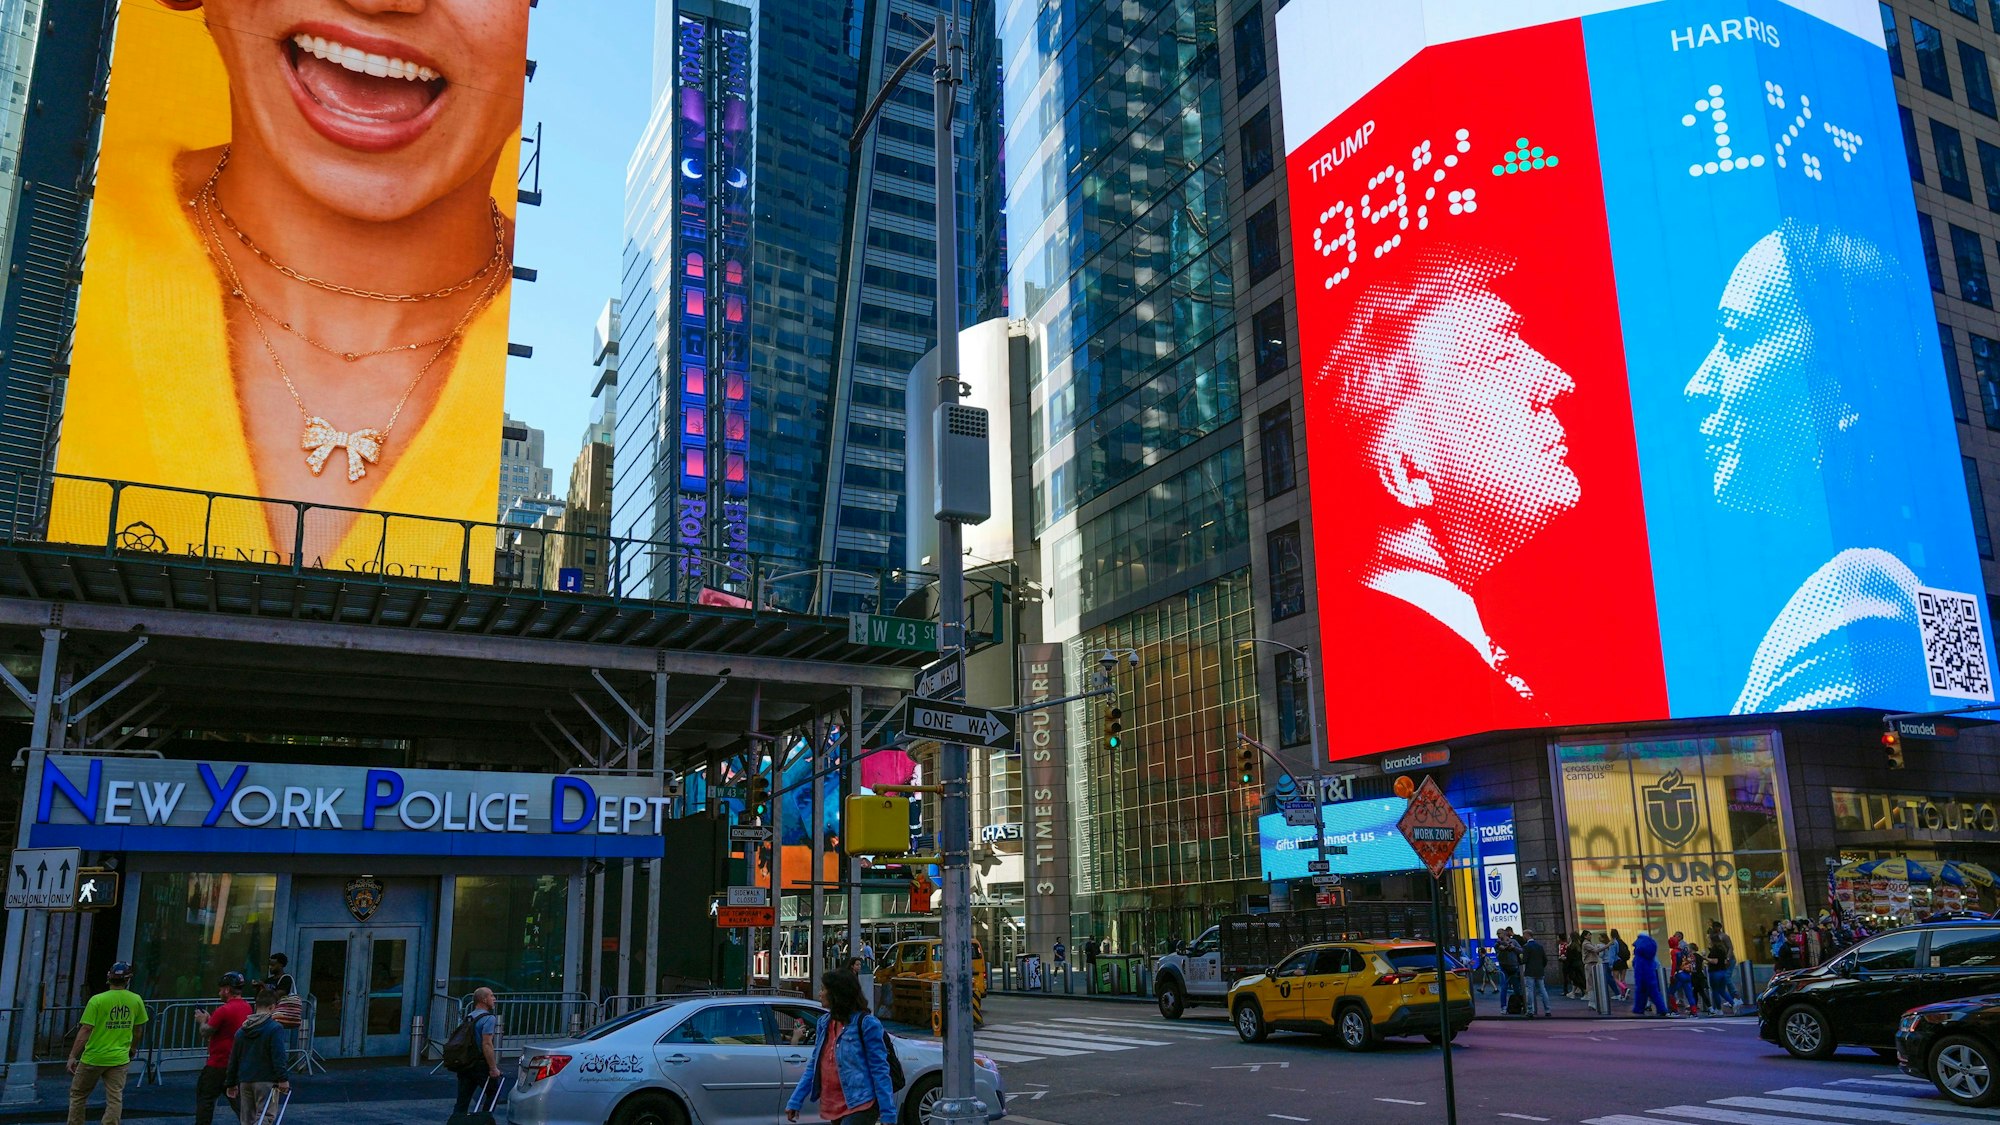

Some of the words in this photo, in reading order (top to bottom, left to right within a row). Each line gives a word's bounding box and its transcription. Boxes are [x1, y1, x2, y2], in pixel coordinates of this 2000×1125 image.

[1670, 16, 1781, 52] HARRIS
[1307, 120, 1376, 184] TRUMP
[1312, 128, 1478, 290] 99%
[873, 620, 888, 643] W
[897, 622, 916, 646] 43
[924, 625, 935, 640] St
[921, 678, 935, 696] ONE
[940, 666, 956, 684] WAY
[1031, 663, 1051, 762] SQUARE
[922, 711, 954, 730] ONE
[968, 718, 999, 736] WAY
[1900, 721, 1936, 736] branded
[1385, 752, 1422, 770] branded
[1592, 762, 1615, 772] river
[1566, 772, 1605, 781] campus
[1897, 800, 1999, 831] TOURO
[1034, 788, 1054, 866] TIMES
[1414, 828, 1434, 840] WORK
[1435, 829, 1454, 840] ZONE
[1361, 832, 1375, 842] us
[1623, 861, 1735, 884] TOURO
[1037, 881, 1055, 895] 3
[1630, 884, 1732, 898] UNIVERSITY
[8, 895, 27, 904] ONLY
[29, 894, 48, 903] ONLY
[50, 894, 71, 903] ONLY
[736, 896, 758, 904] CLOSED
